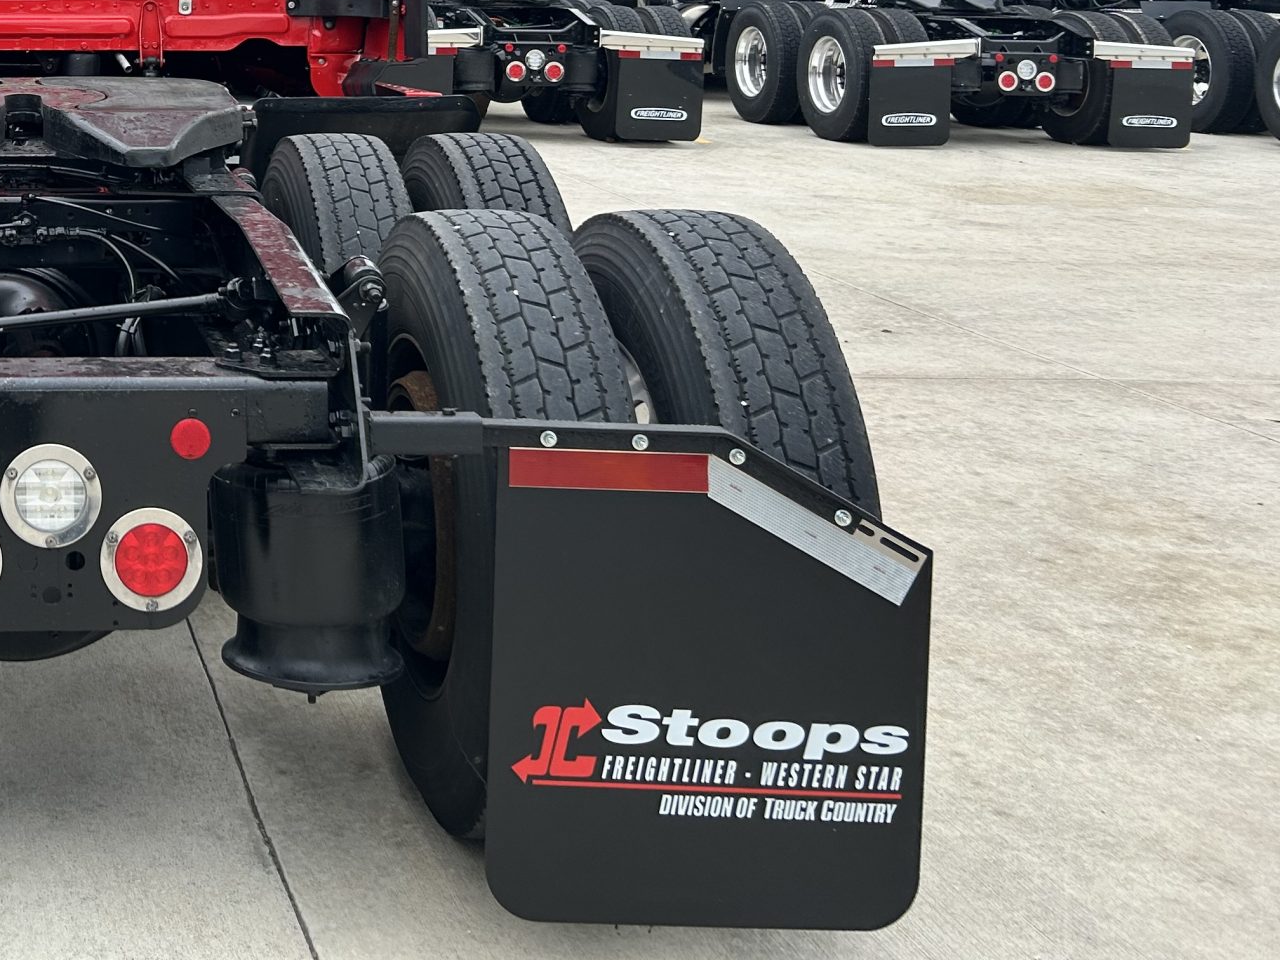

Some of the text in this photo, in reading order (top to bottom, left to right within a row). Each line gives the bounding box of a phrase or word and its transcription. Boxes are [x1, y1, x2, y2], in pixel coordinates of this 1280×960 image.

[636, 110, 682, 118] FREIGHTLINER
[602, 705, 910, 760] Stoops
[602, 756, 738, 784] FREIGHTLINER
[761, 762, 849, 788] WESTERN
[855, 766, 903, 790] STAR
[658, 795, 898, 823] DIVISION OF TRUCK COUNTRY
